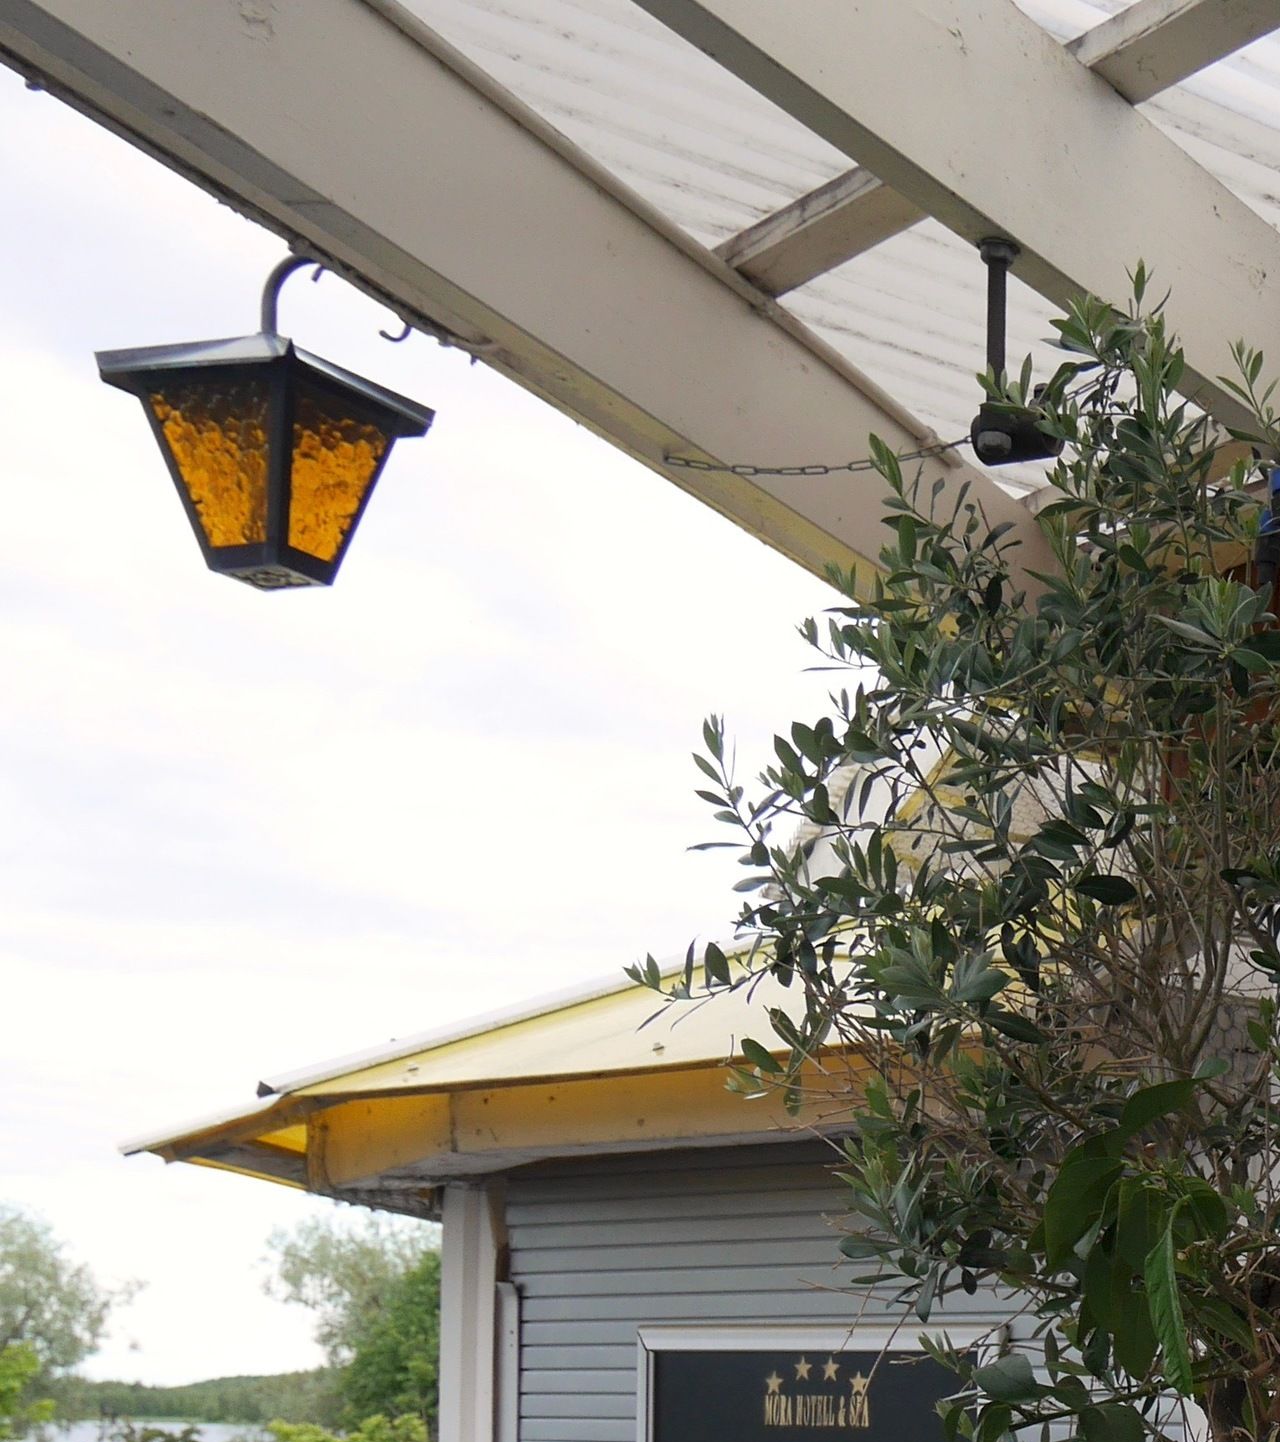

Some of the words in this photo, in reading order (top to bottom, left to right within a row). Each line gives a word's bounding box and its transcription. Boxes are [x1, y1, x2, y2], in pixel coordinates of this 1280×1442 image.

[764, 1394, 792, 1426] MORA
[796, 1394, 835, 1427] HOTELL
[838, 1395, 846, 1427] &
[849, 1394, 869, 1428] SPA
